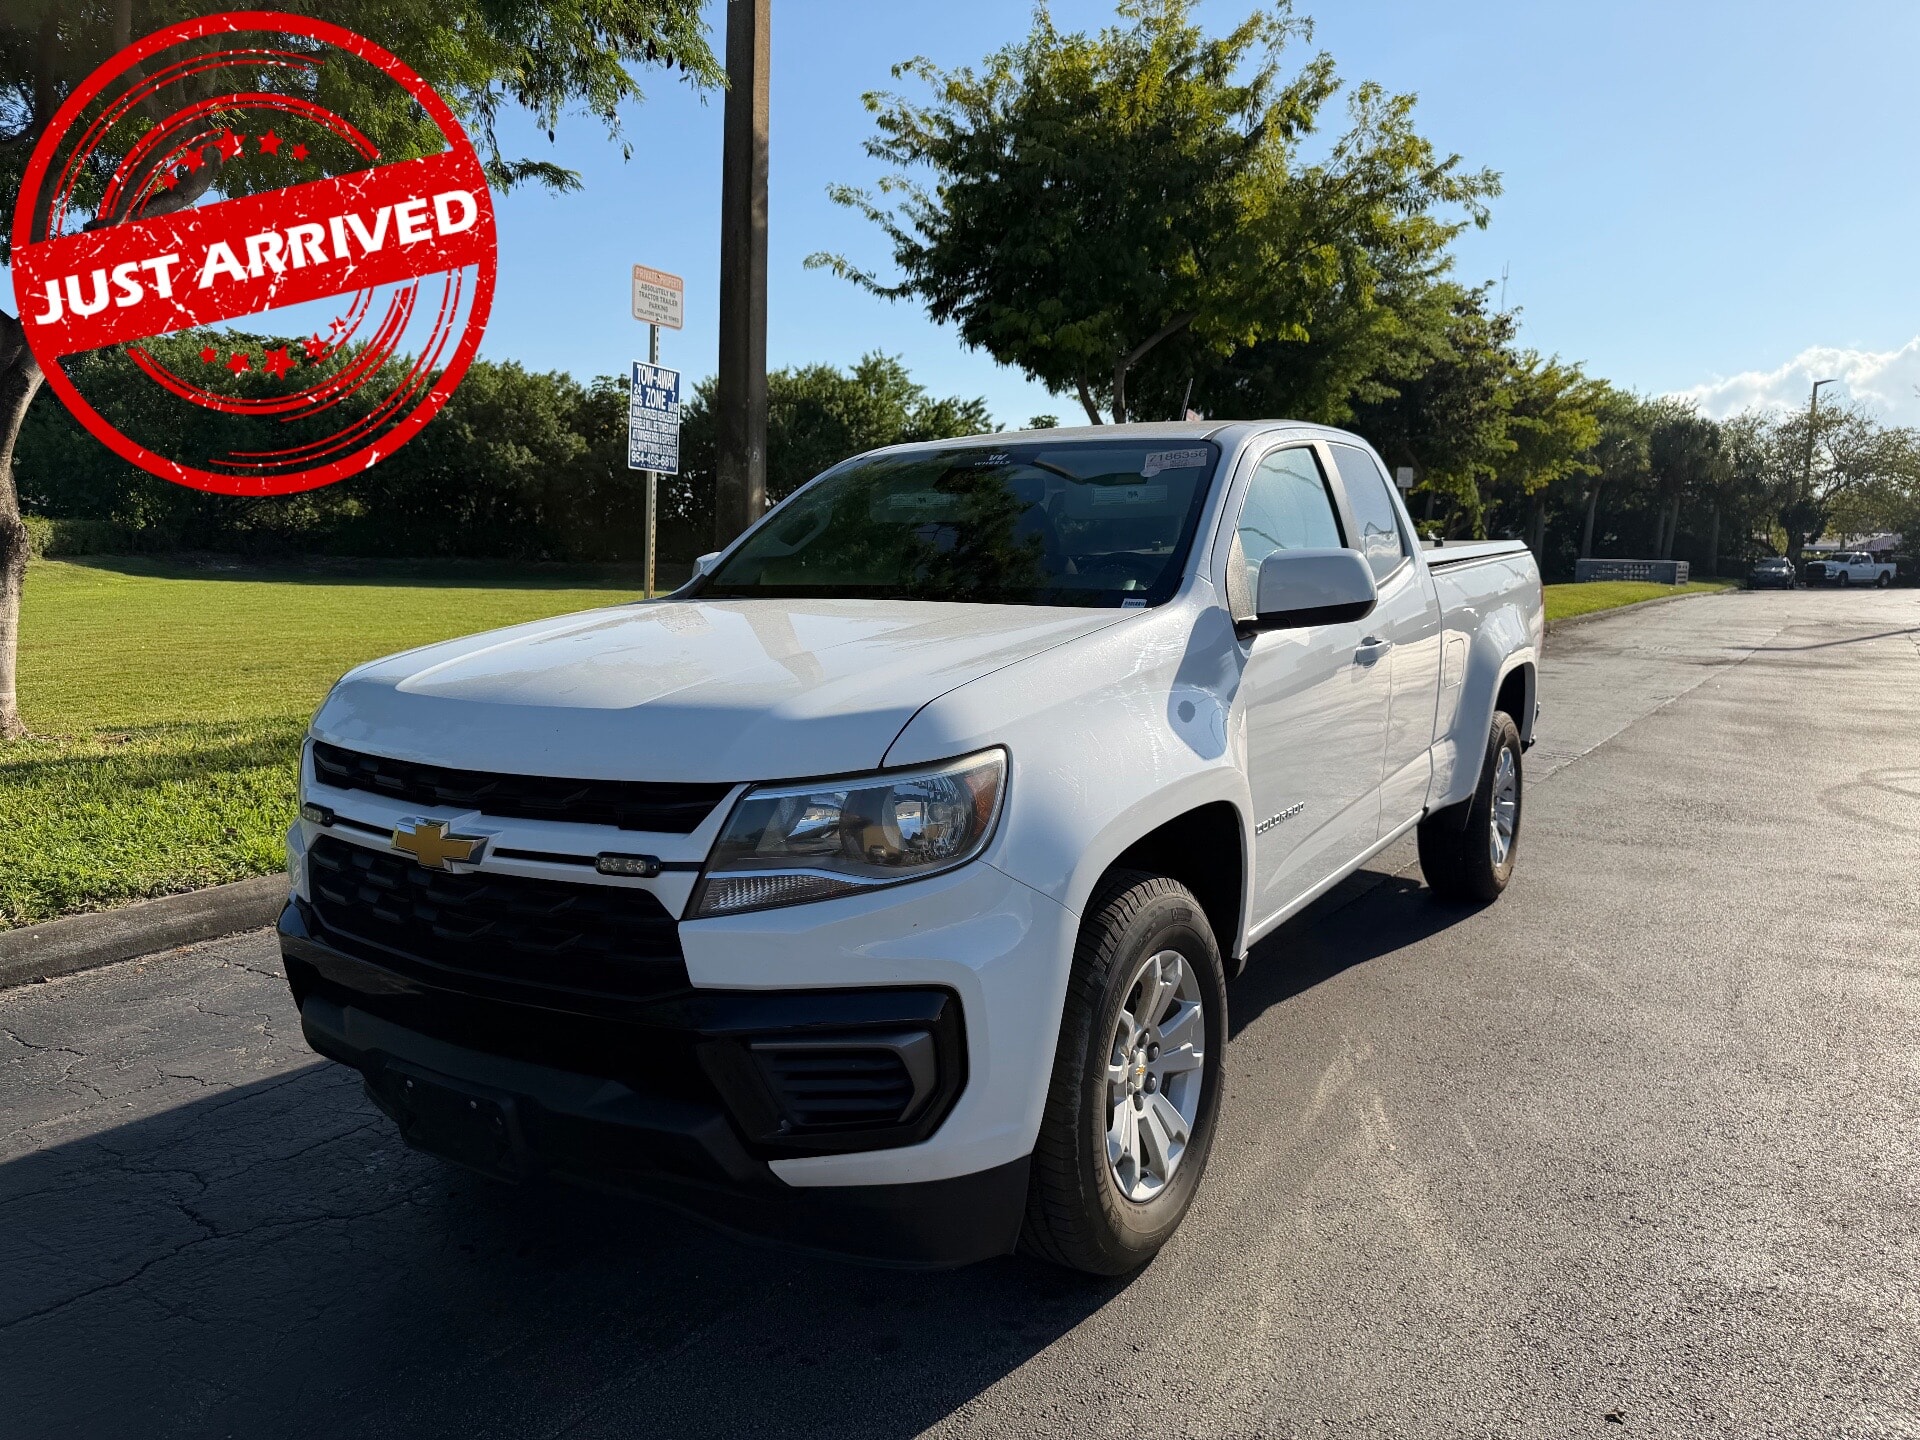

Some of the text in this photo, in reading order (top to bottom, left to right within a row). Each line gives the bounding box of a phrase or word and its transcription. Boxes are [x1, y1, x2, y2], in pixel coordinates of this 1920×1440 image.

[641, 283, 676, 299] ABSOLUTELY NO
[639, 290, 678, 307] TRACTOR TRAILER
[649, 301, 669, 313] PARKING
[637, 364, 676, 391] TOW-AWAY
[634, 383, 642, 395] 24
[632, 394, 643, 407] HRS
[646, 387, 666, 410] ZONE
[671, 391, 676, 402] 7
[667, 401, 678, 413] DAYS
[1255, 801, 1305, 836] COLORADO
